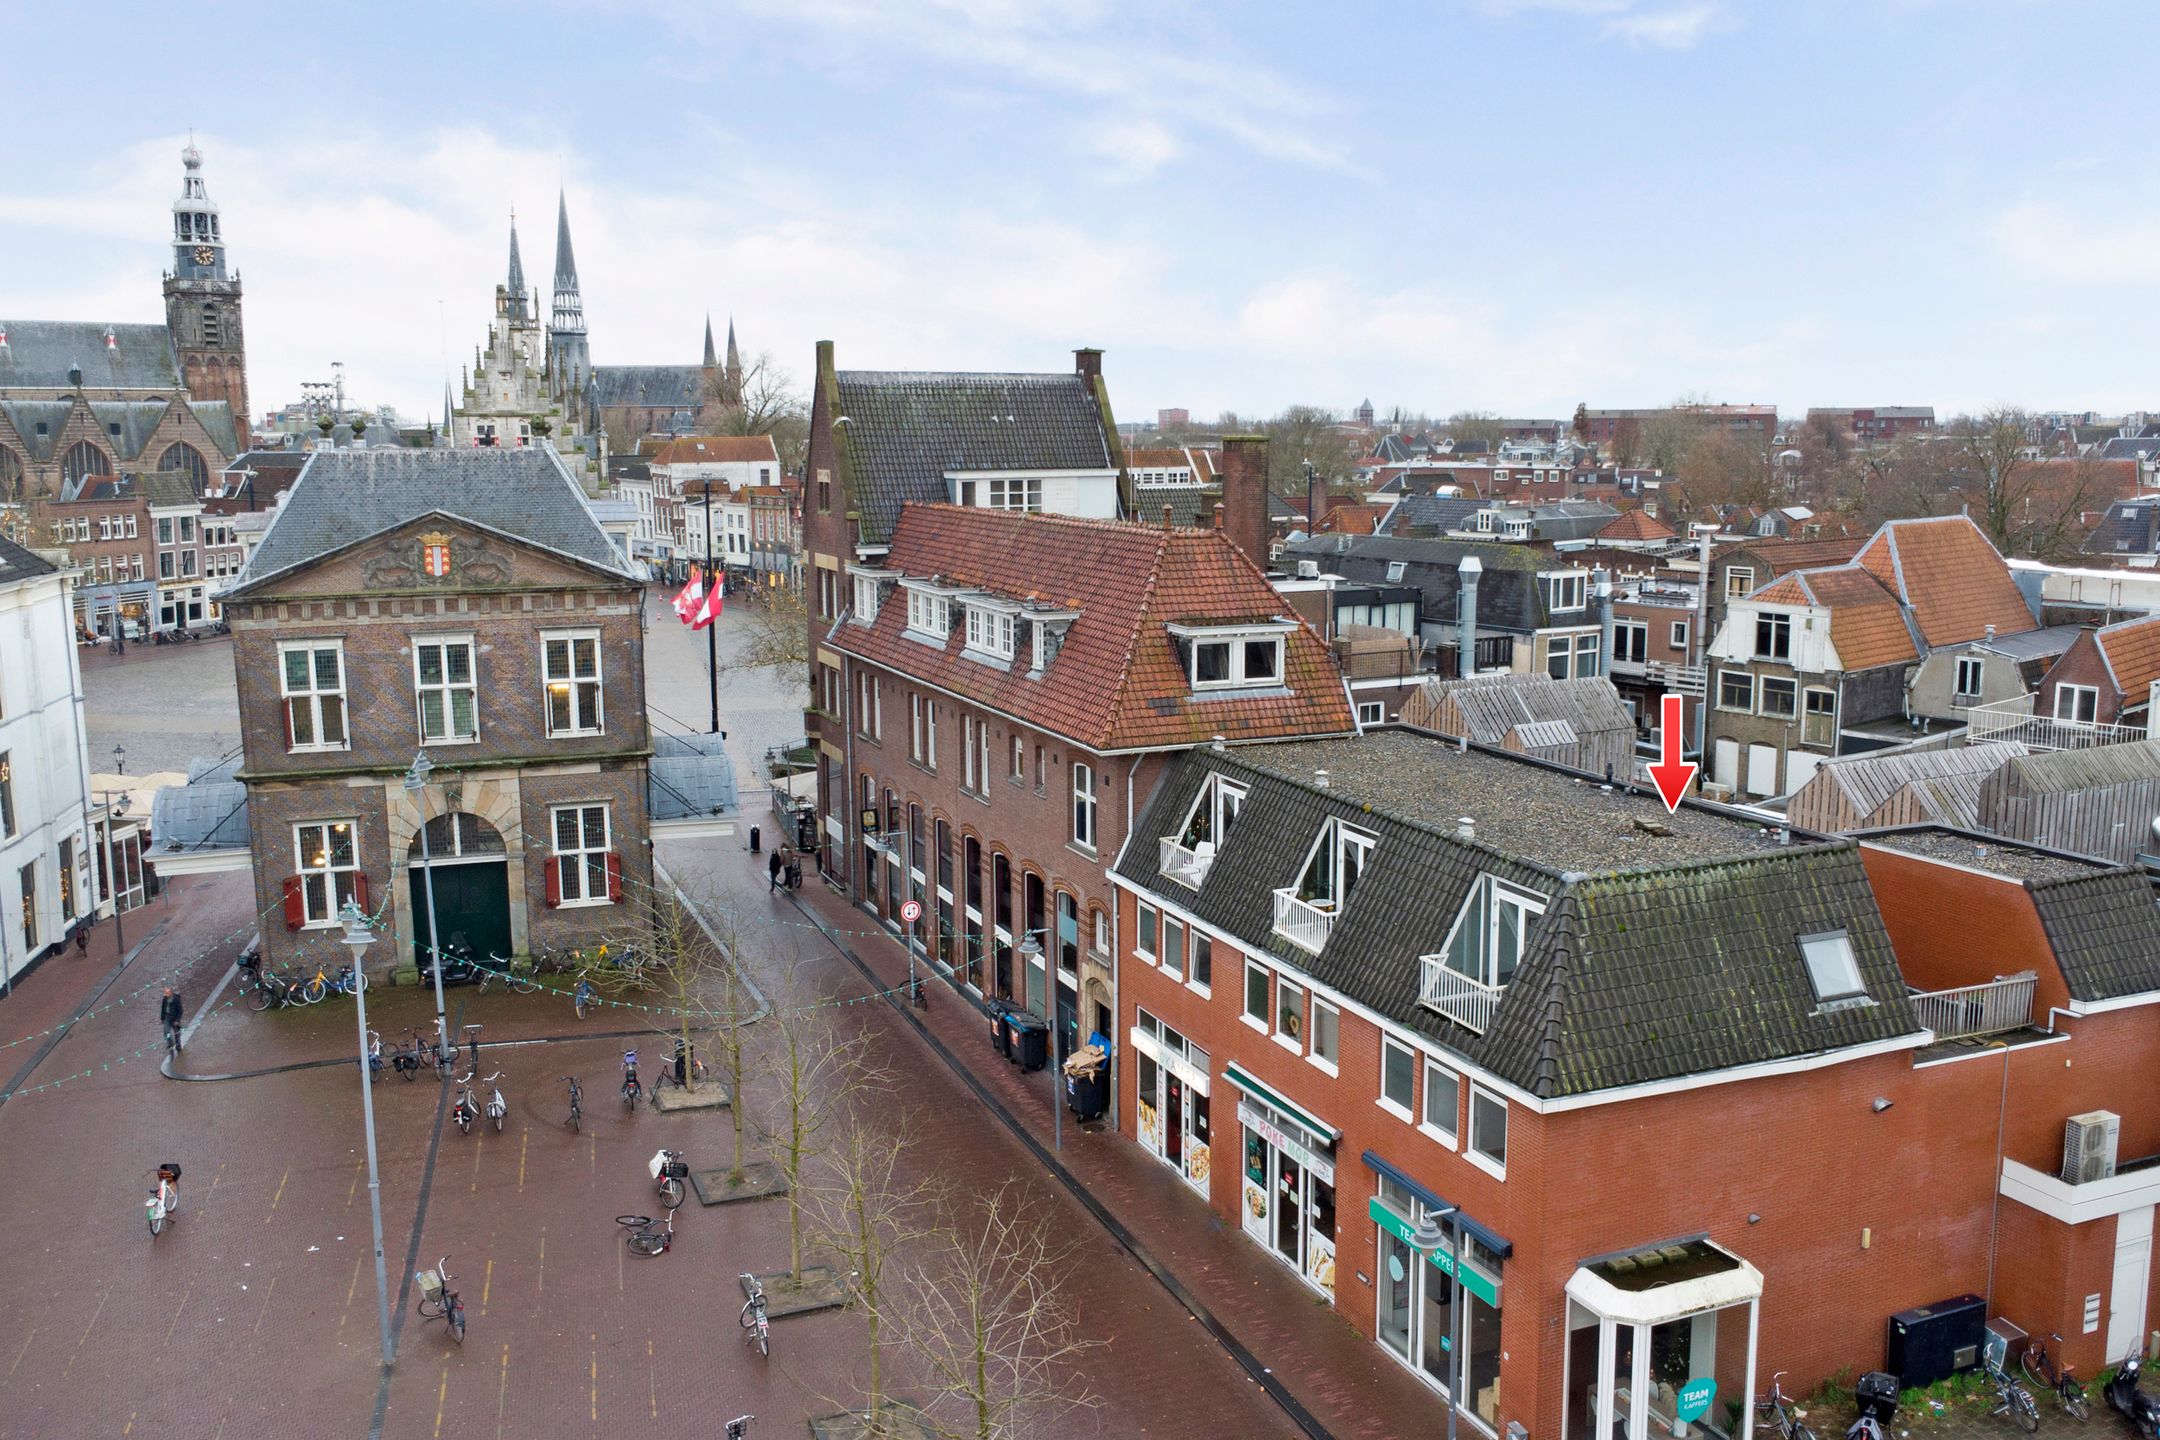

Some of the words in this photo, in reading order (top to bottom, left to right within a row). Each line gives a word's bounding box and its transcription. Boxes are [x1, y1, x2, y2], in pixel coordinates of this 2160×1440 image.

[1259, 1120, 1285, 1150] POKE
[1432, 1250, 1462, 1279] APPES
[1683, 1388, 1709, 1402] TEAM
